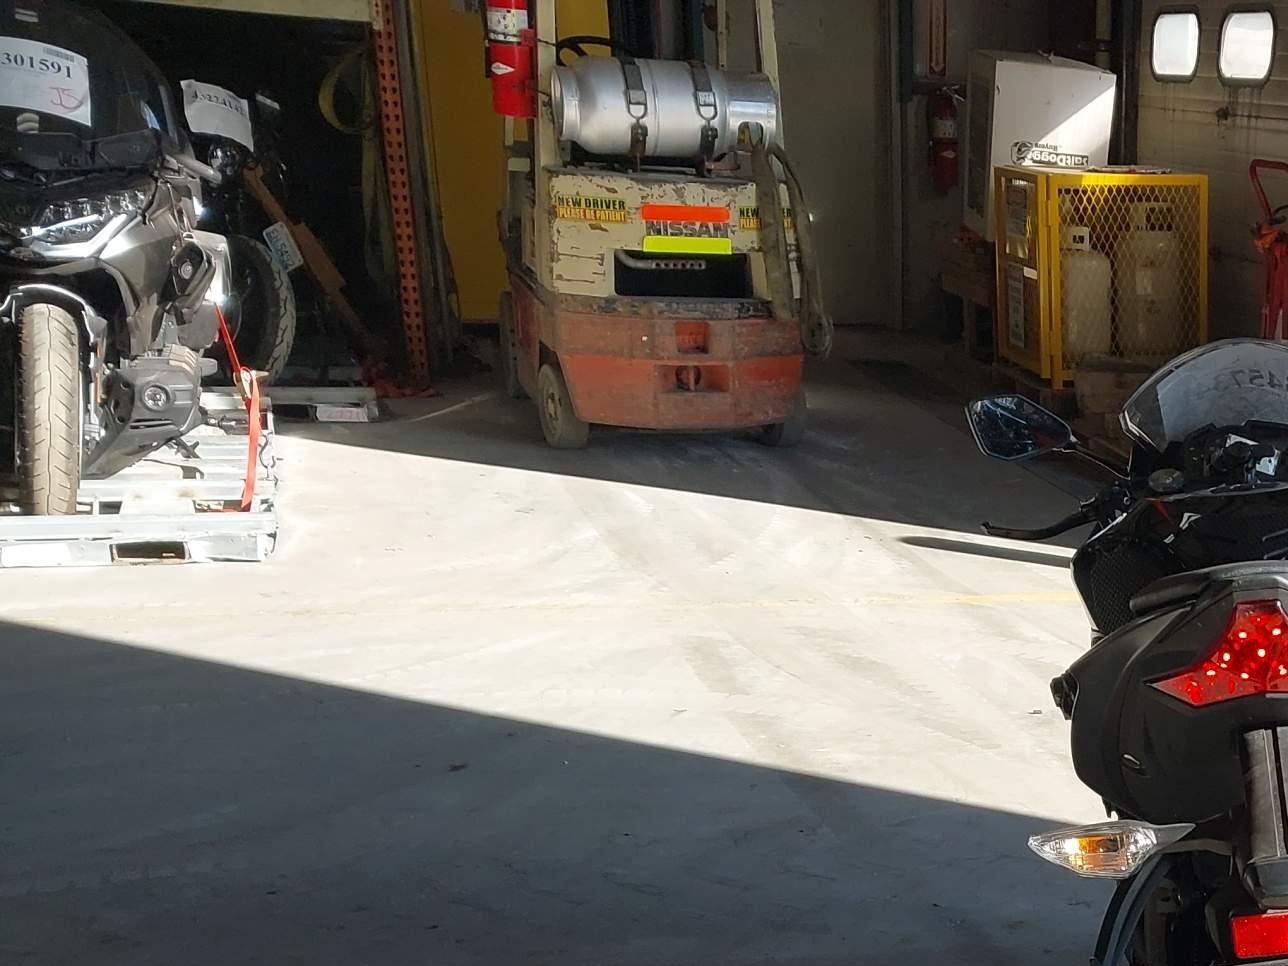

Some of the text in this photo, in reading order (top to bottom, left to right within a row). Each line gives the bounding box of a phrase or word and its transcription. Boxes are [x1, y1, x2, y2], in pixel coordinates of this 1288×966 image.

[1, 52, 72, 79] 301591
[557, 195, 626, 210] NEW DRIVER
[739, 207, 760, 218] NEW
[645, 219, 729, 239] NISSAN
